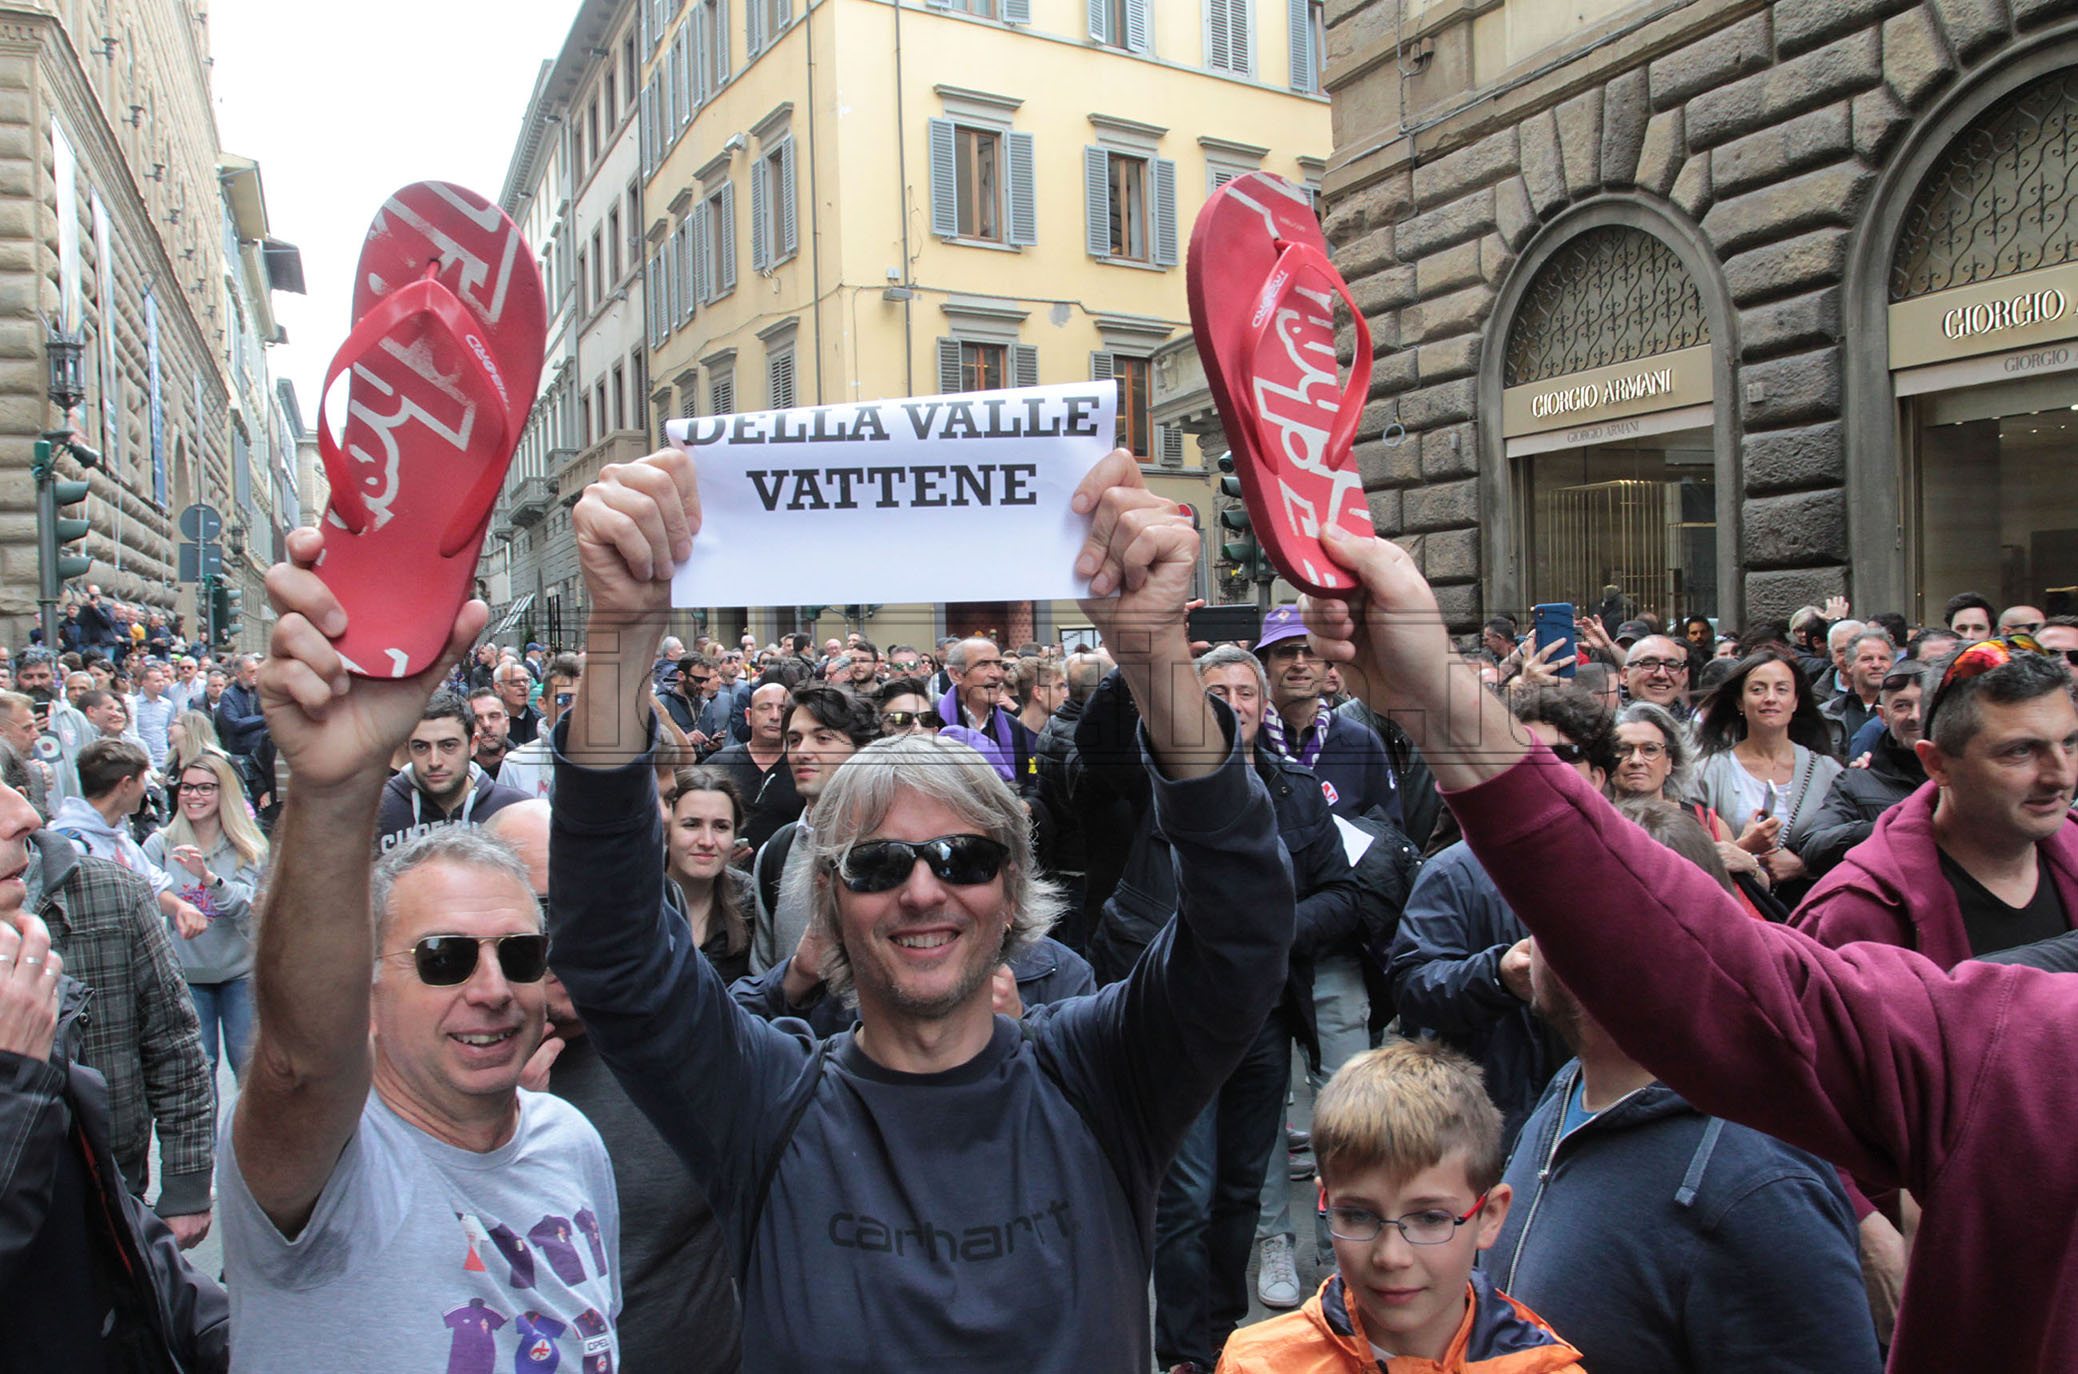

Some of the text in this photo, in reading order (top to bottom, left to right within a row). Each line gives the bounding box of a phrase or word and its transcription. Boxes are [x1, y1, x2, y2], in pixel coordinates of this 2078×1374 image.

[1943, 288, 2066, 340] GIORGIO
[2004, 348, 2069, 373] GIORGIO
[1531, 368, 1673, 418] GIORGIO ARMANI
[683, 395, 1100, 446] DELLA VALLE
[1567, 421, 1640, 443] GIORGIO ARMANI
[746, 464, 1037, 511] VATTENE
